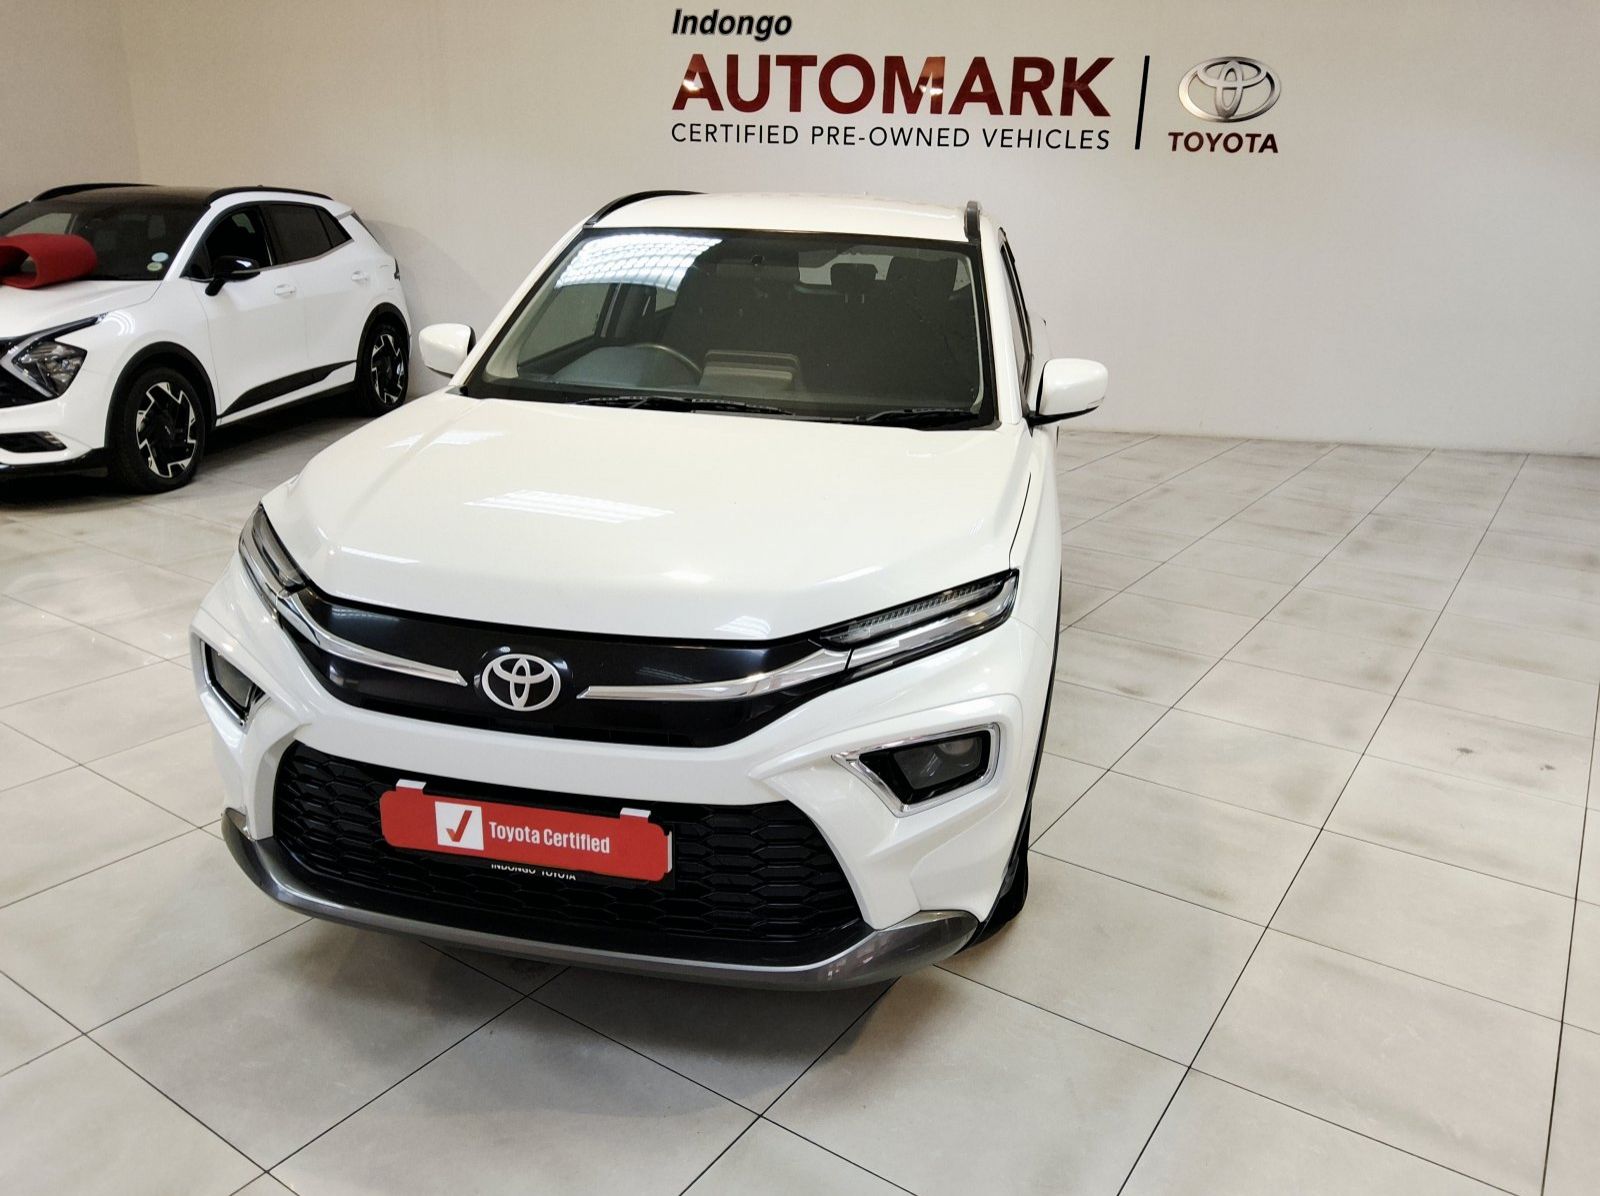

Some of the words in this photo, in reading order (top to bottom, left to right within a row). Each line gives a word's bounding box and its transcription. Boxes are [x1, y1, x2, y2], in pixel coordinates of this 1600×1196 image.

[671, 8, 793, 42] Indongo
[671, 53, 1116, 118] AUTOMARK
[671, 122, 799, 145] CERTIFIED
[811, 125, 970, 148] PRE-OWNED
[982, 127, 1110, 150] VEHICLES
[1167, 131, 1279, 154] TOYOTA
[488, 821, 541, 844] Toyota
[543, 828, 611, 854] Certified
